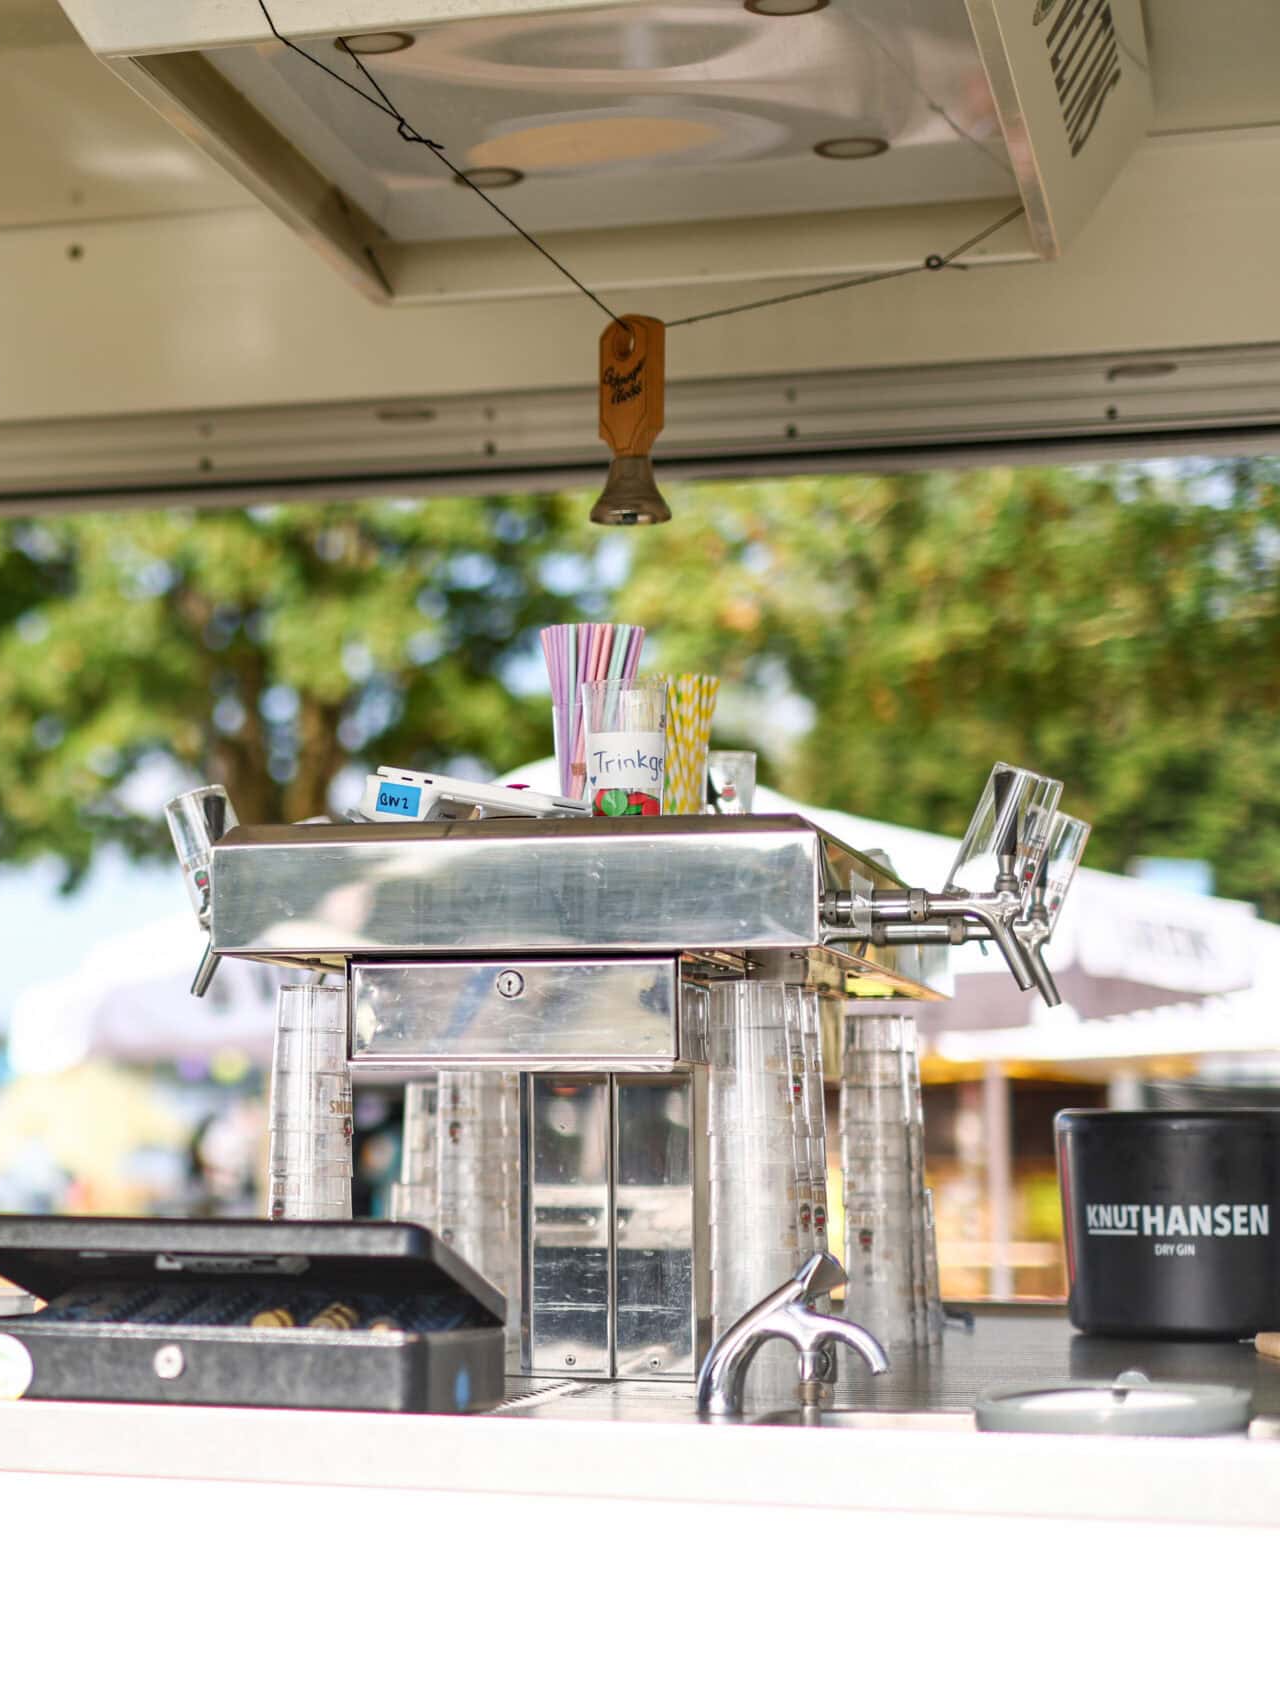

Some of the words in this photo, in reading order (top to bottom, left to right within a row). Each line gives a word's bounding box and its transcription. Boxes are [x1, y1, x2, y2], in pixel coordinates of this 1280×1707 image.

[1086, 1204, 1140, 1228] KNUT
[1143, 1204, 1270, 1237] HANSEN
[1154, 1243, 1175, 1257] DRY
[1176, 1243, 1196, 1257] GIN
